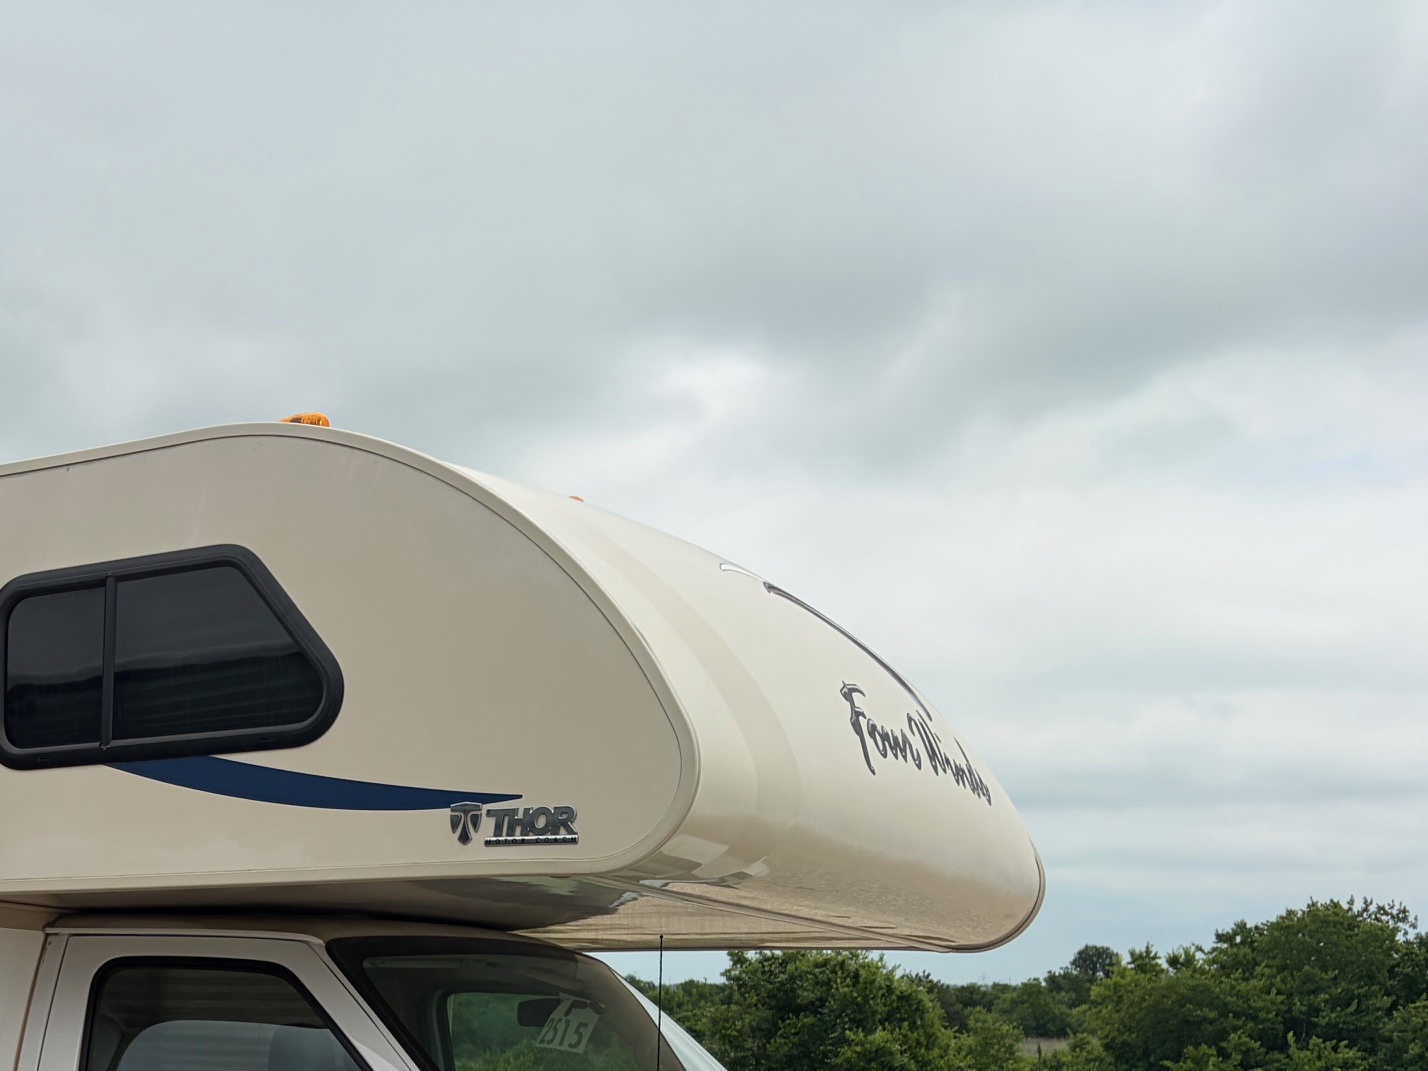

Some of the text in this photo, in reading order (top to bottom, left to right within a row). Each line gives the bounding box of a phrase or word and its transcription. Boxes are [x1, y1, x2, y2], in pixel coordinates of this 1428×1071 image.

[839, 680, 992, 806] Four Winds
[486, 805, 578, 837] THOR
[538, 1018, 589, 1049] 2515
